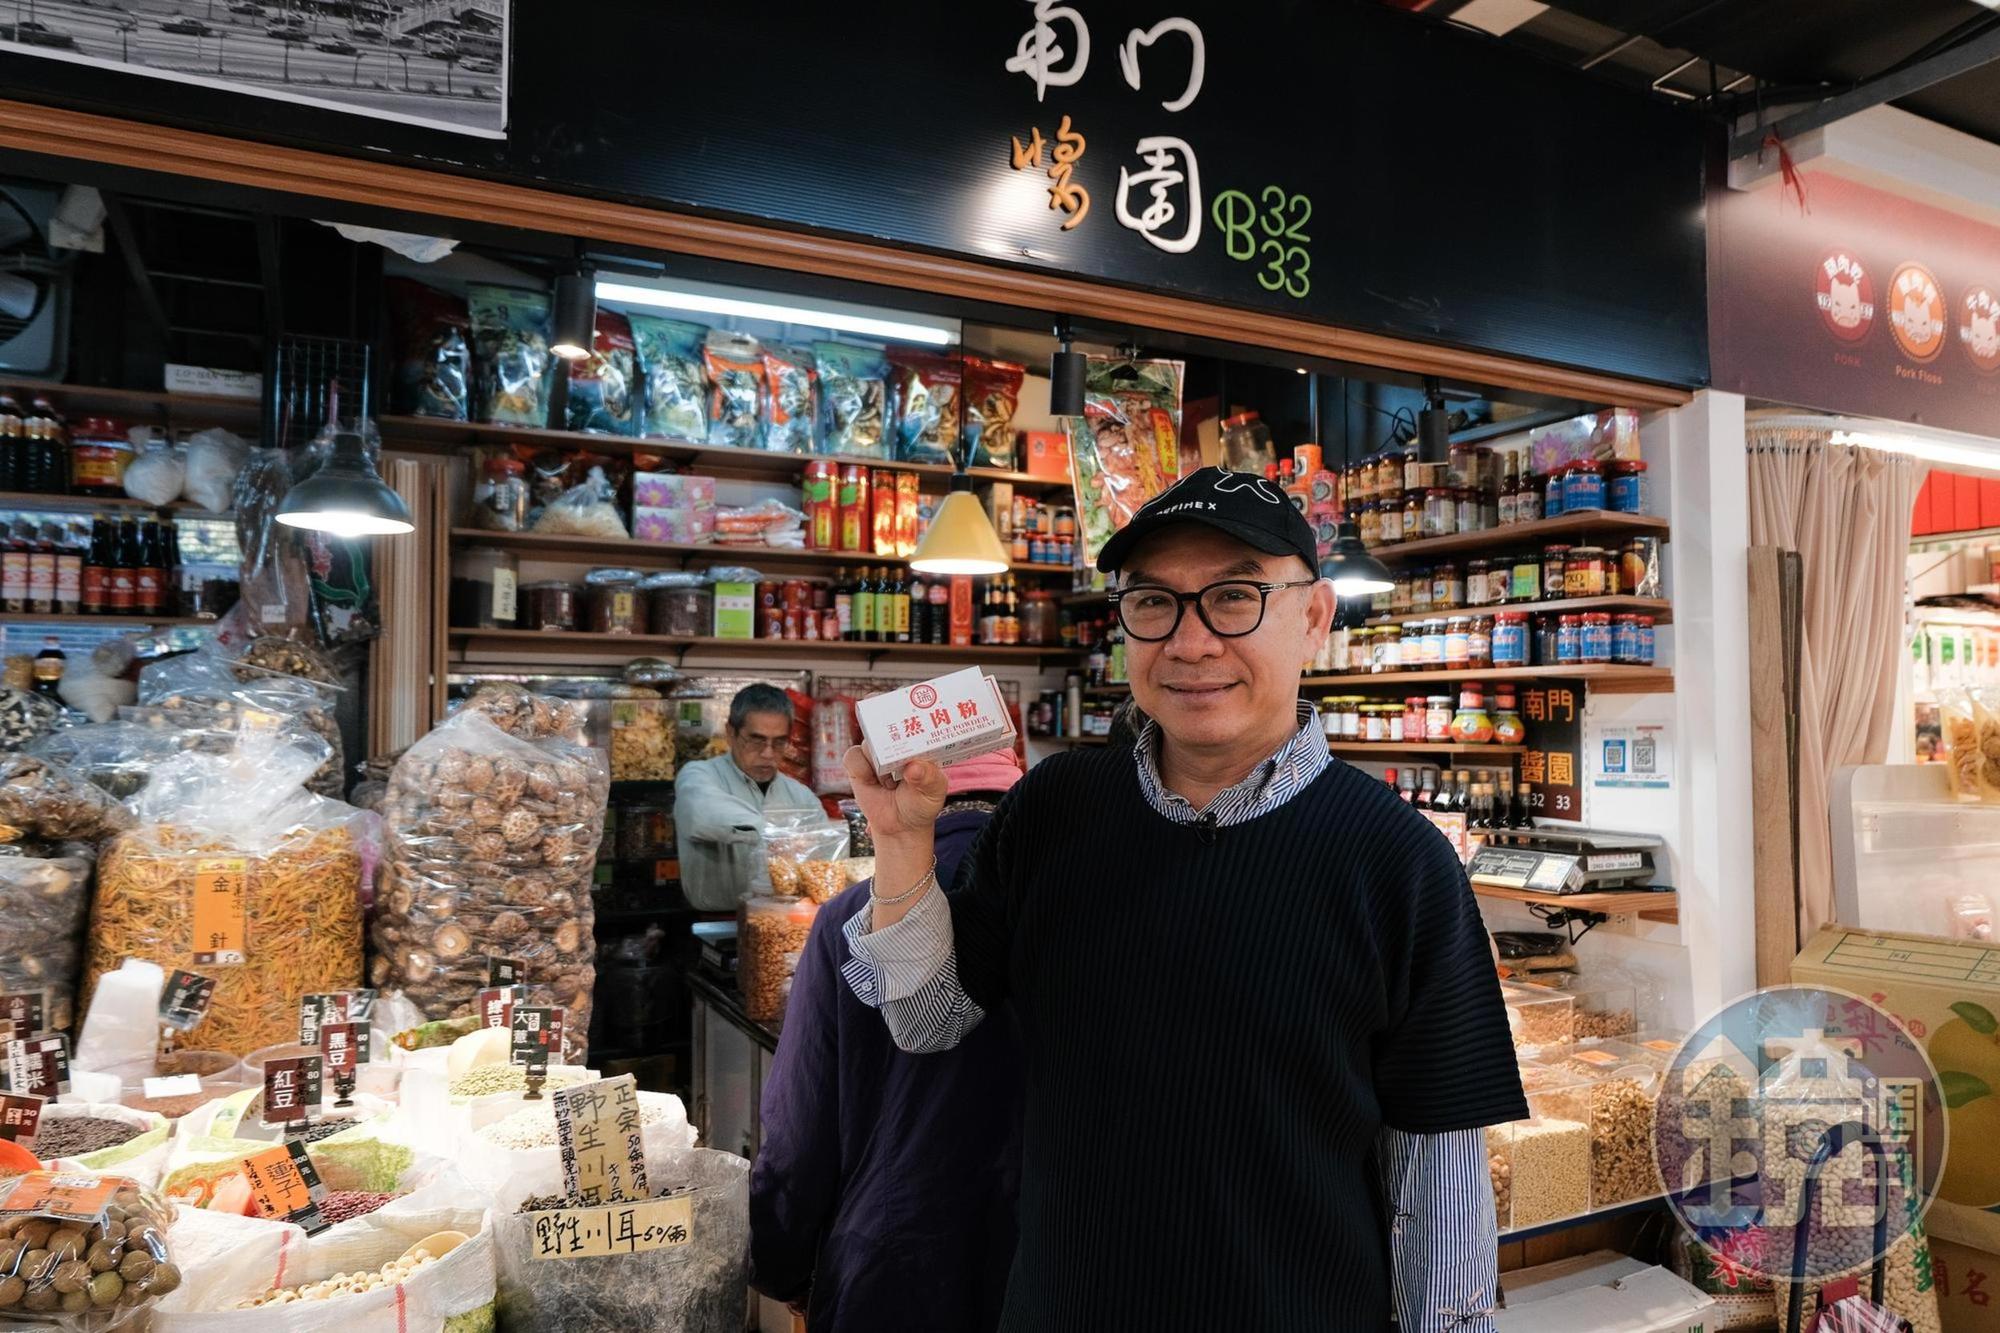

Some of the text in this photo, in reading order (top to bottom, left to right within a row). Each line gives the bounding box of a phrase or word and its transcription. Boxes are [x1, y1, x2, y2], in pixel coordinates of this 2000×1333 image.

[1257, 240, 1310, 298] 33
[1895, 365, 1916, 378] Pork
[903, 699, 978, 738] 蒸肉粉
[953, 715, 989, 730] POWDER
[1522, 689, 1573, 722] 南門
[1521, 750, 1573, 786] 醬園
[1556, 794, 1571, 810] 33
[273, 1070, 296, 1109] 紅豆
[614, 1083, 640, 1134] 正宗
[536, 1209, 642, 1254] 野生川耳
